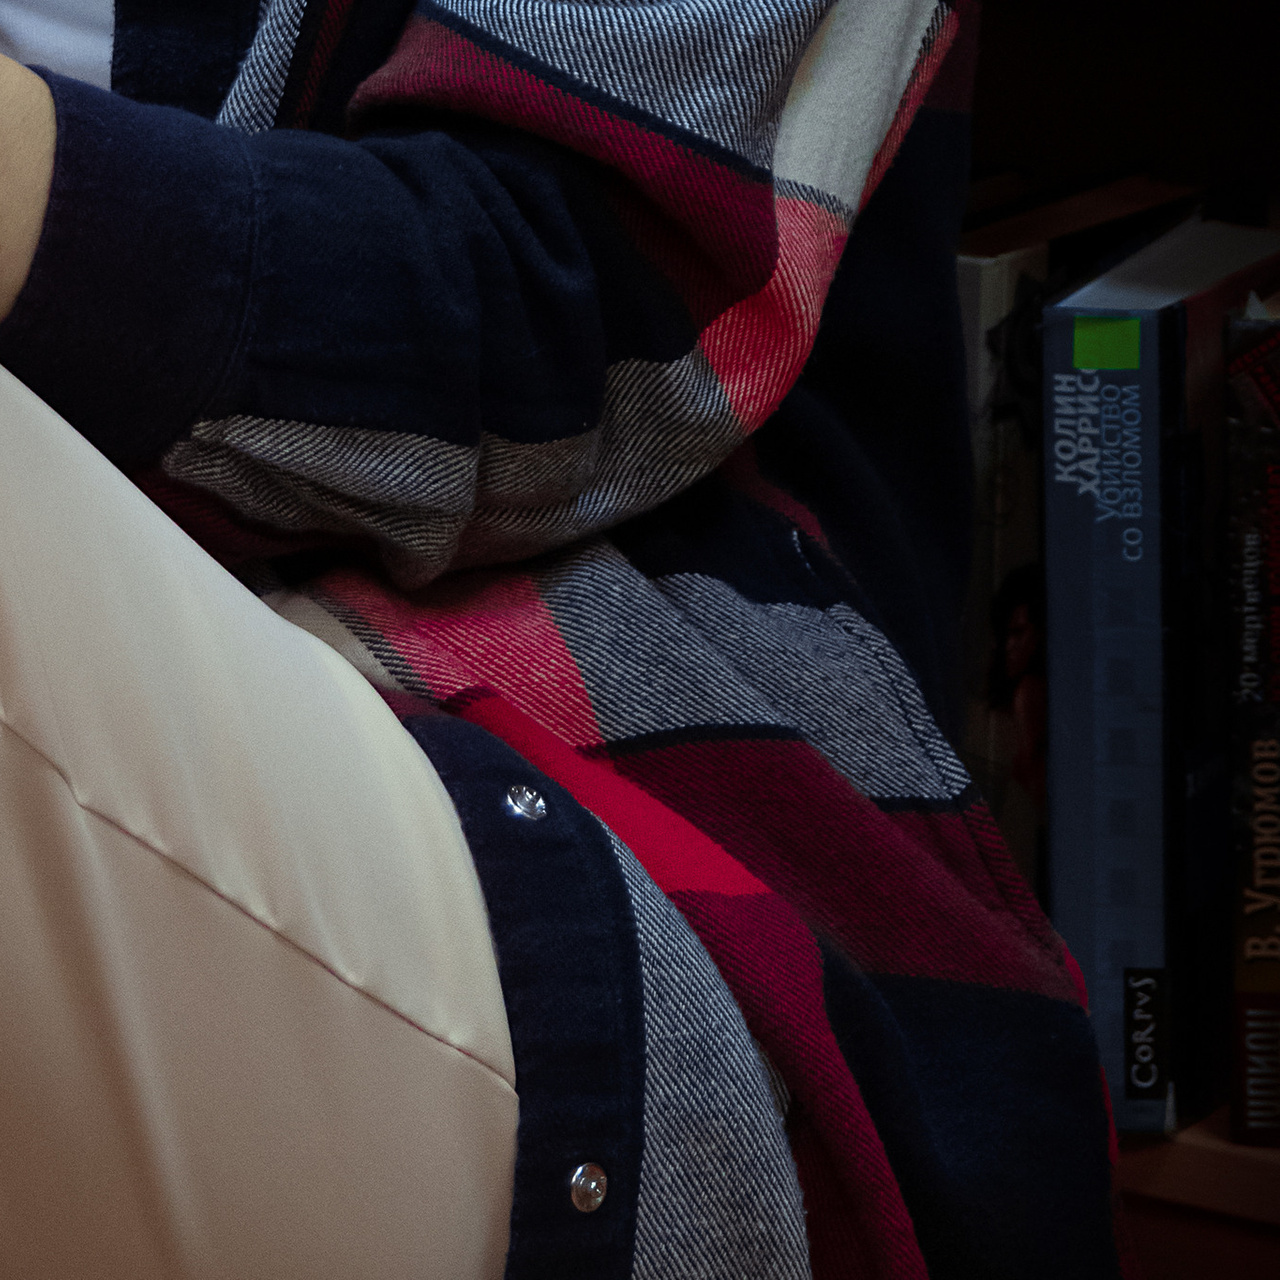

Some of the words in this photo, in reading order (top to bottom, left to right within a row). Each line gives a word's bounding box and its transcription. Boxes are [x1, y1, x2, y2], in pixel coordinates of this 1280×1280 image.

[1053, 373, 1080, 483] КОЛИН
[1076, 368, 1100, 497] ХАРРИС
[1121, 384, 1143, 519] ВЗЛОМОМ
